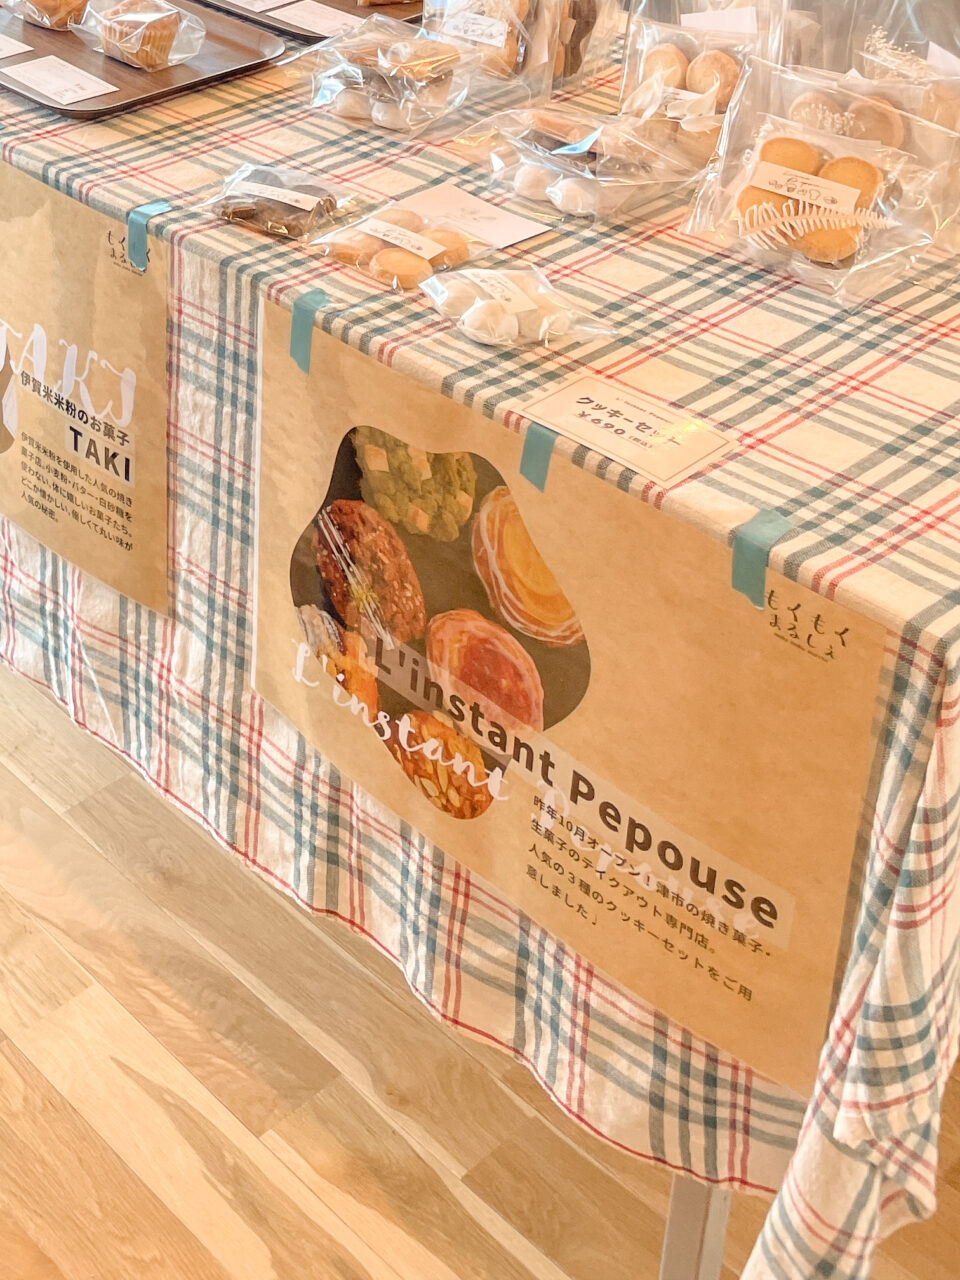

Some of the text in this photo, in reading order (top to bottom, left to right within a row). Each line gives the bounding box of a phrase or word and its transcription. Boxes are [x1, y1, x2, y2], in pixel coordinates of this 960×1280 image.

[20, 370, 130, 447] 伊賀米米粉のお菓子
[69, 425, 131, 482] TAKI
[767, 589, 849, 648] もくもく
[374, 635, 778, 929] L'instant Pepouse
